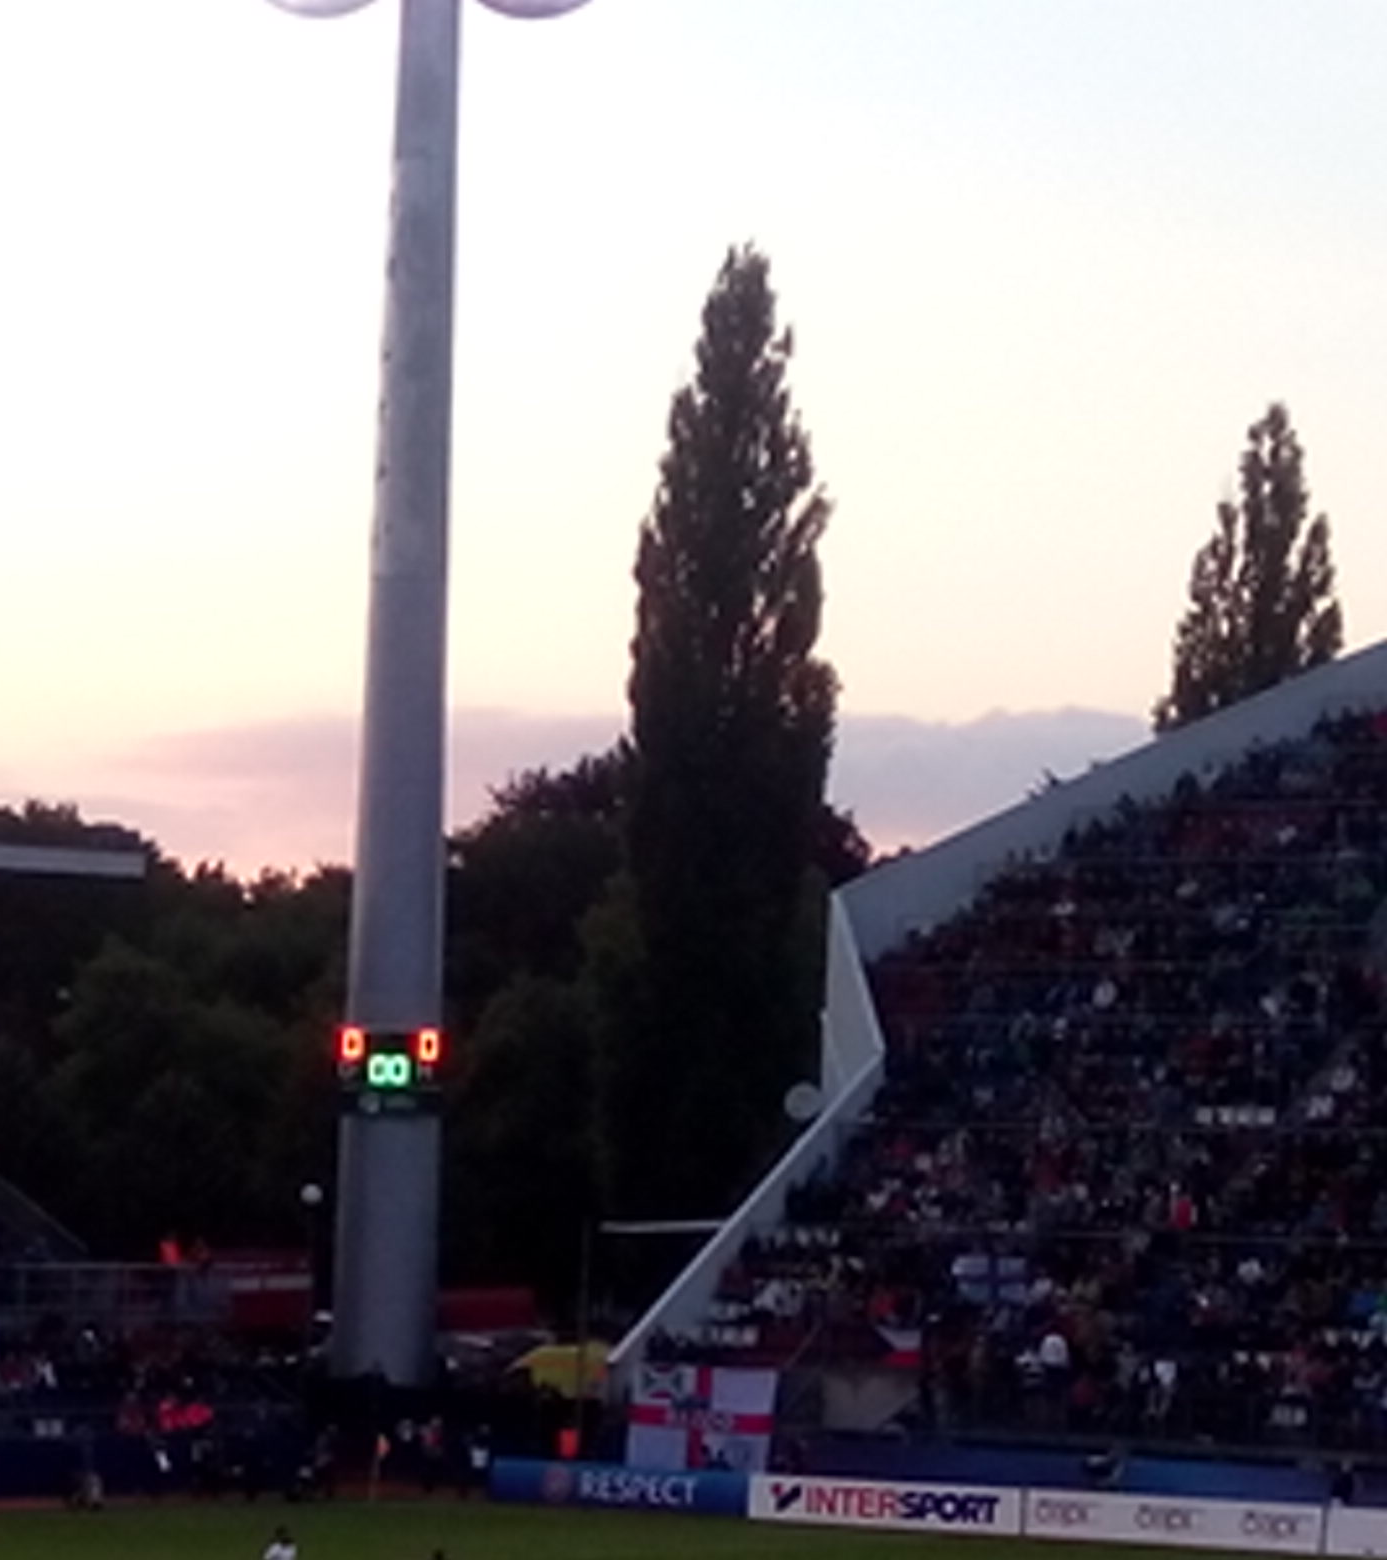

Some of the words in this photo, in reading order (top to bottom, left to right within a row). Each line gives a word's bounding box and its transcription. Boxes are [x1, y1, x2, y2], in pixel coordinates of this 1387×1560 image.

[418, 1028, 440, 1062] 0
[579, 1470, 697, 1505] RESPECT
[805, 1486, 1000, 1524] INTERSPORT
